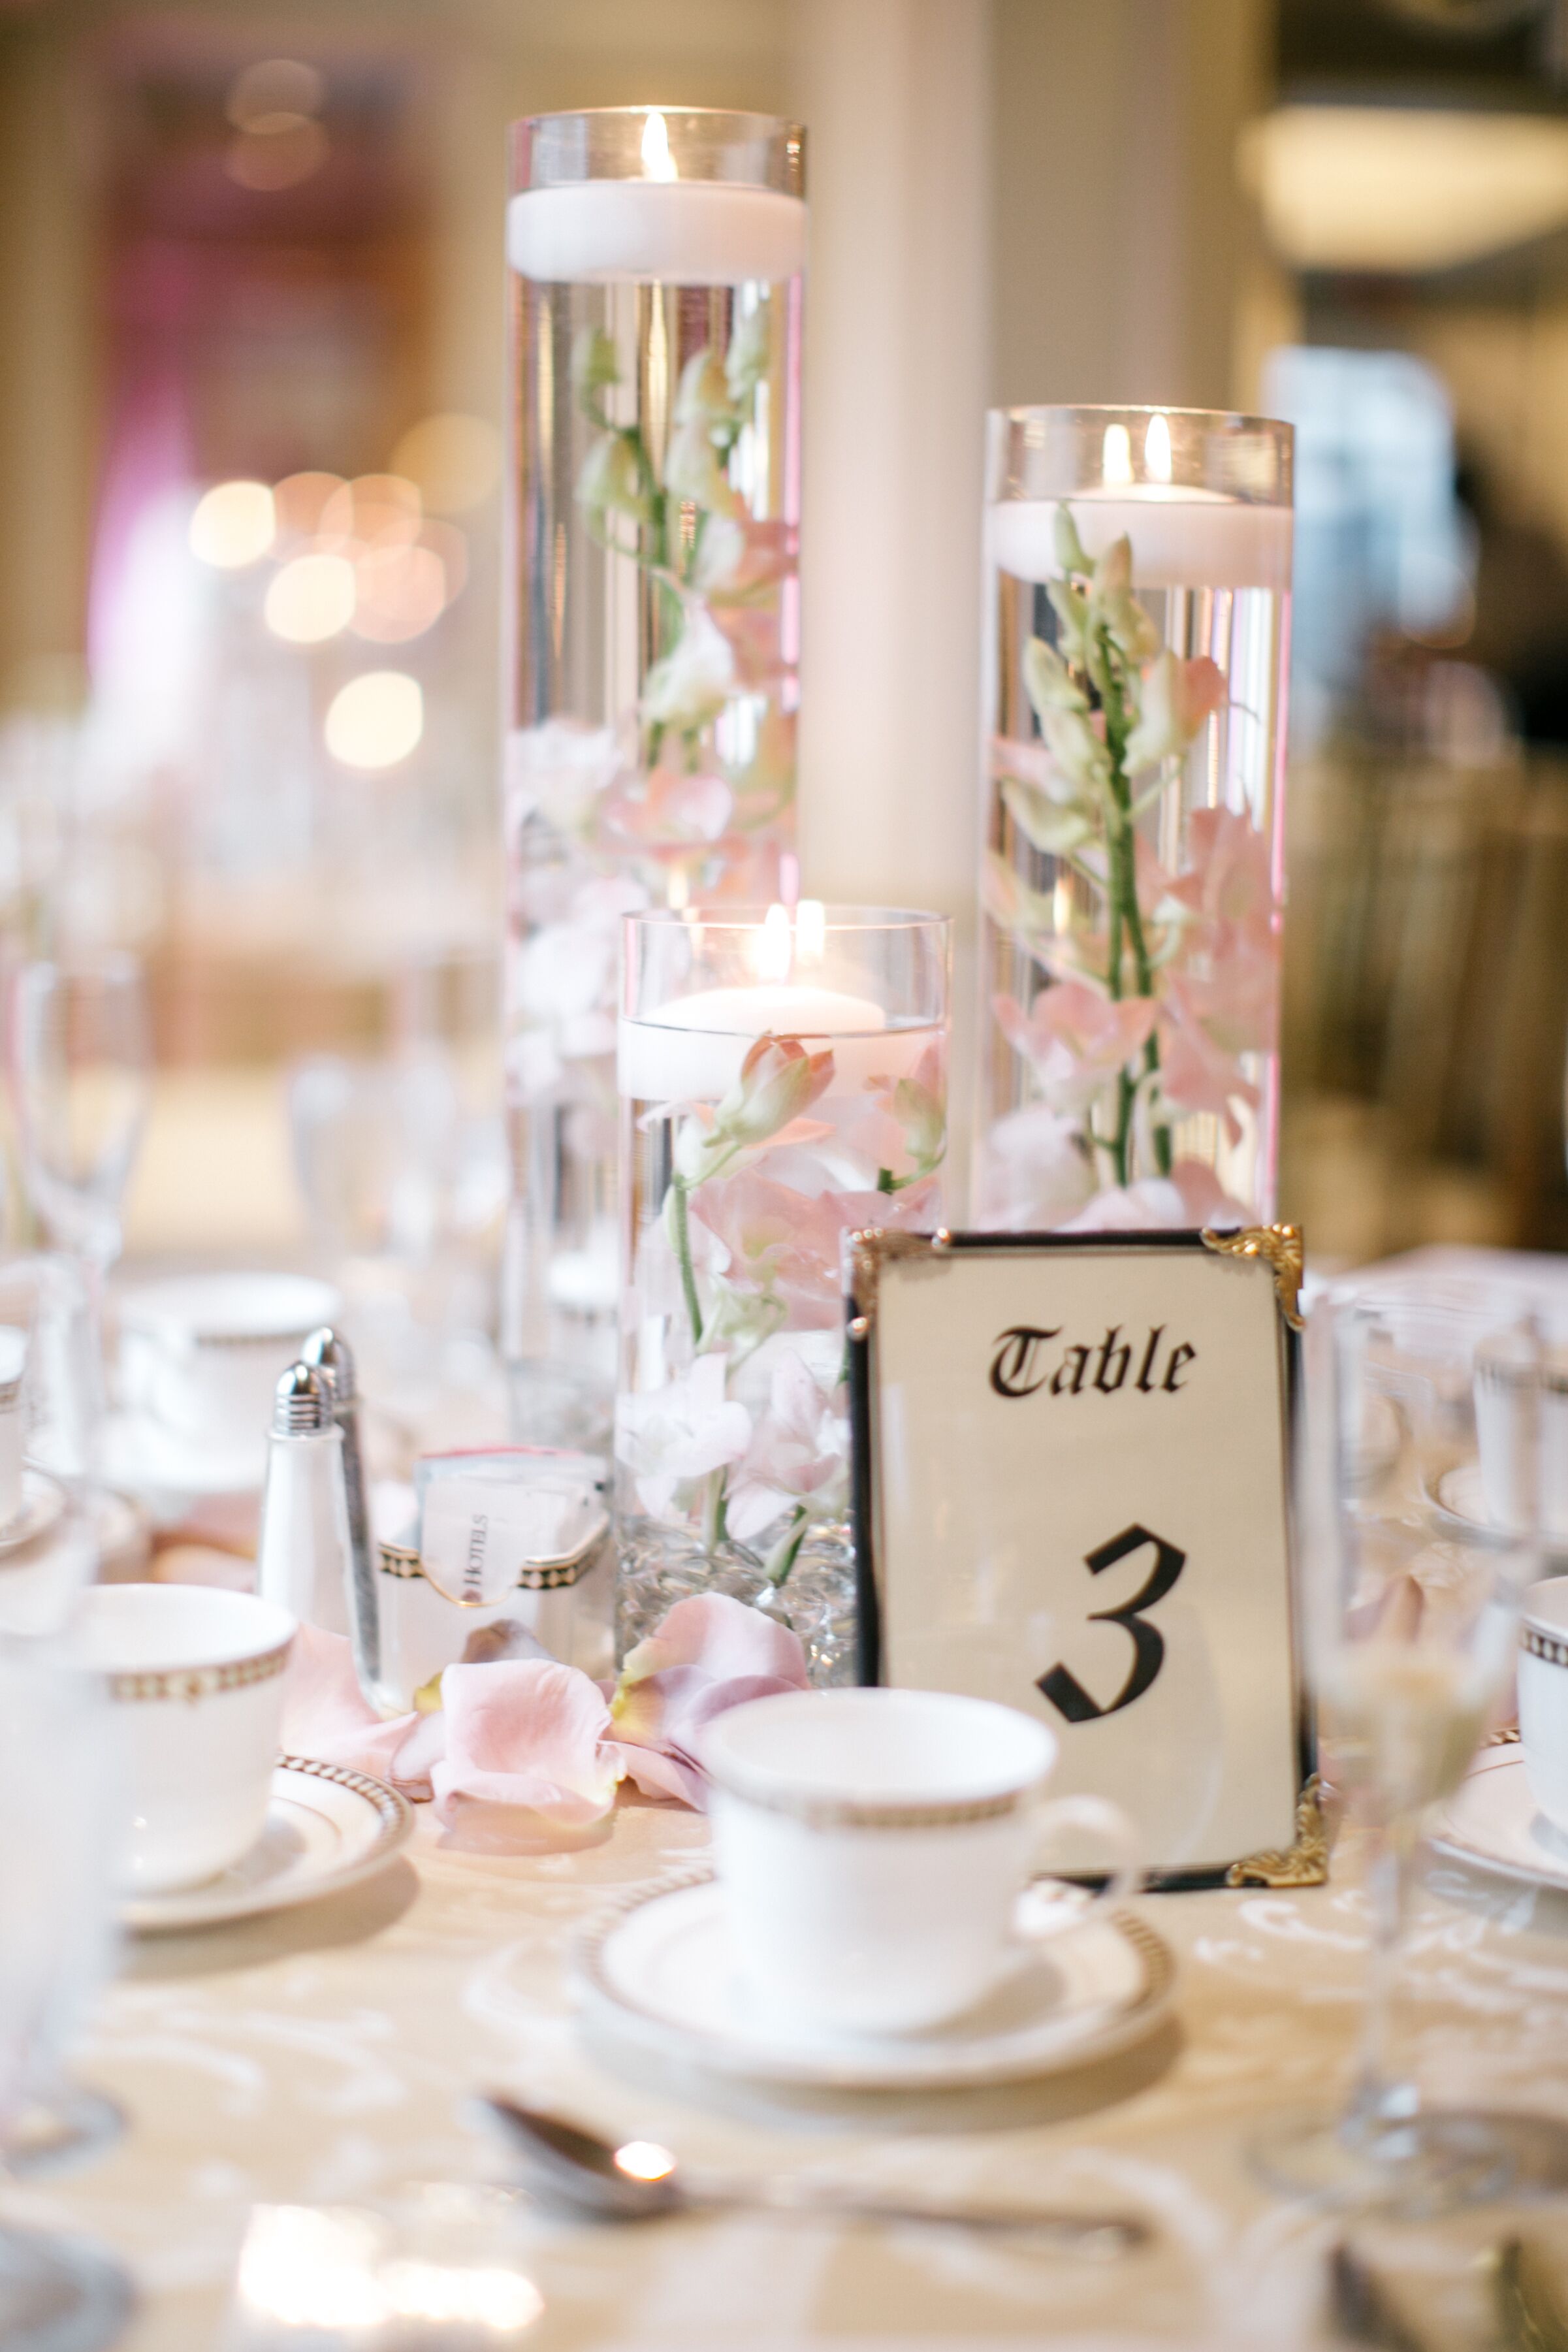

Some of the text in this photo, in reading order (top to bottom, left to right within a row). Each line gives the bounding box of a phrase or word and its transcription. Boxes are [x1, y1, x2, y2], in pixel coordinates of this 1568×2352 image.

[988, 1324, 1198, 1400] Table
[462, 1513, 488, 1585] HOTELS
[1034, 1522, 1188, 1724] 3
